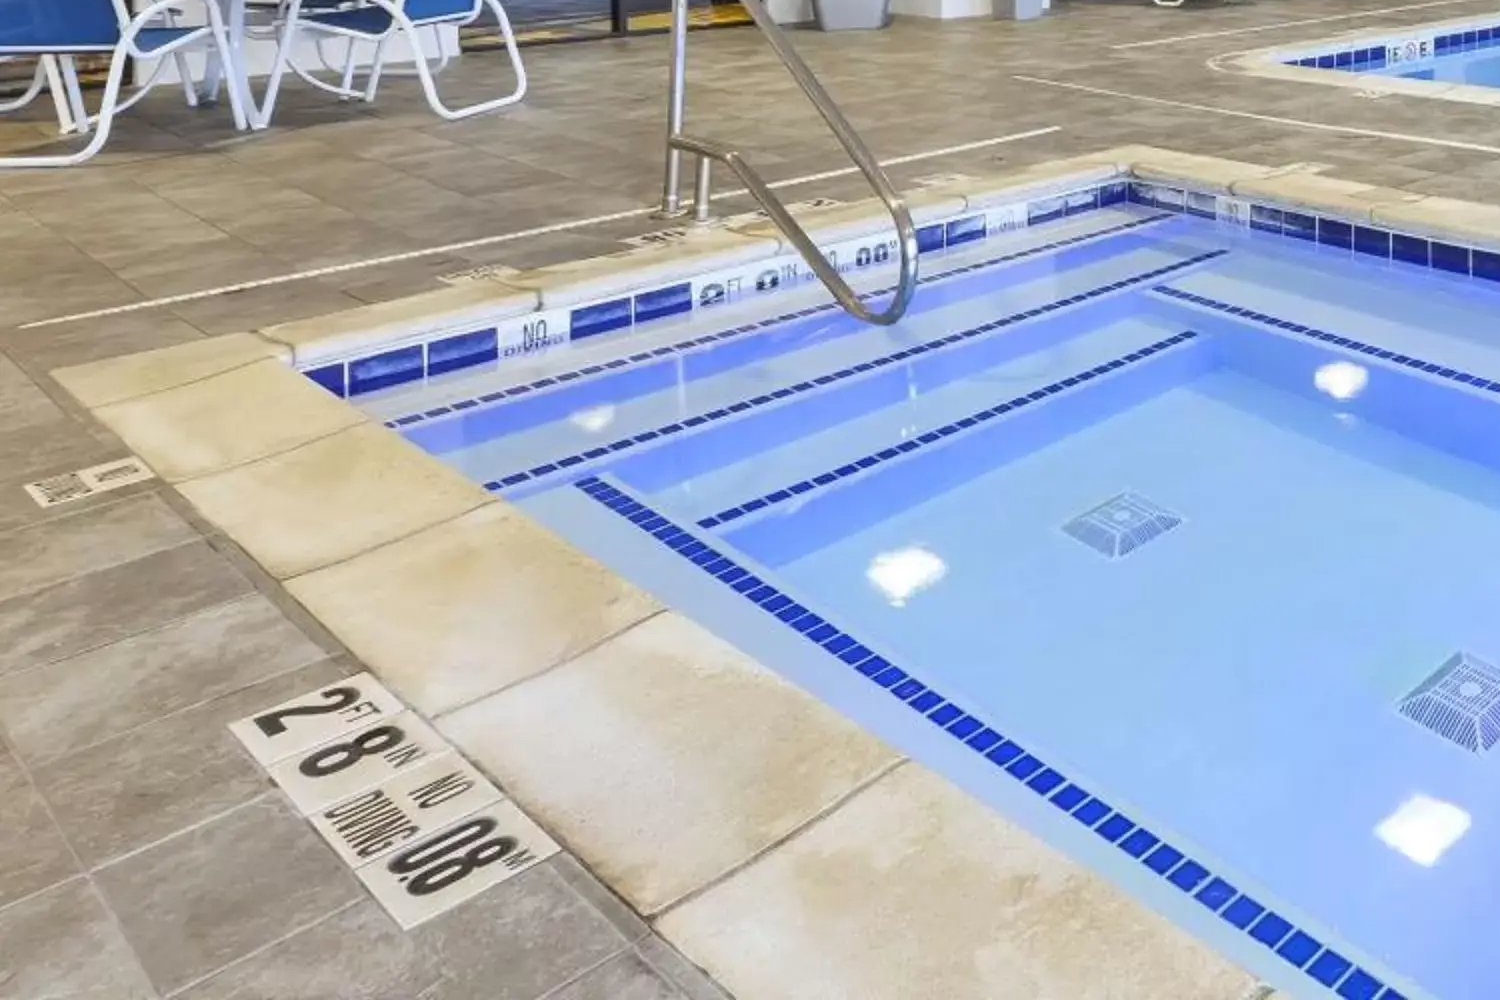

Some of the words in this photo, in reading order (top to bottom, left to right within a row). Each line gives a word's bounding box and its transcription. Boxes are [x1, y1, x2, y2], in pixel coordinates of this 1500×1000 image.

[523, 319, 547, 352] NO
[407, 769, 477, 810] NO
[323, 788, 421, 859] DIVING
